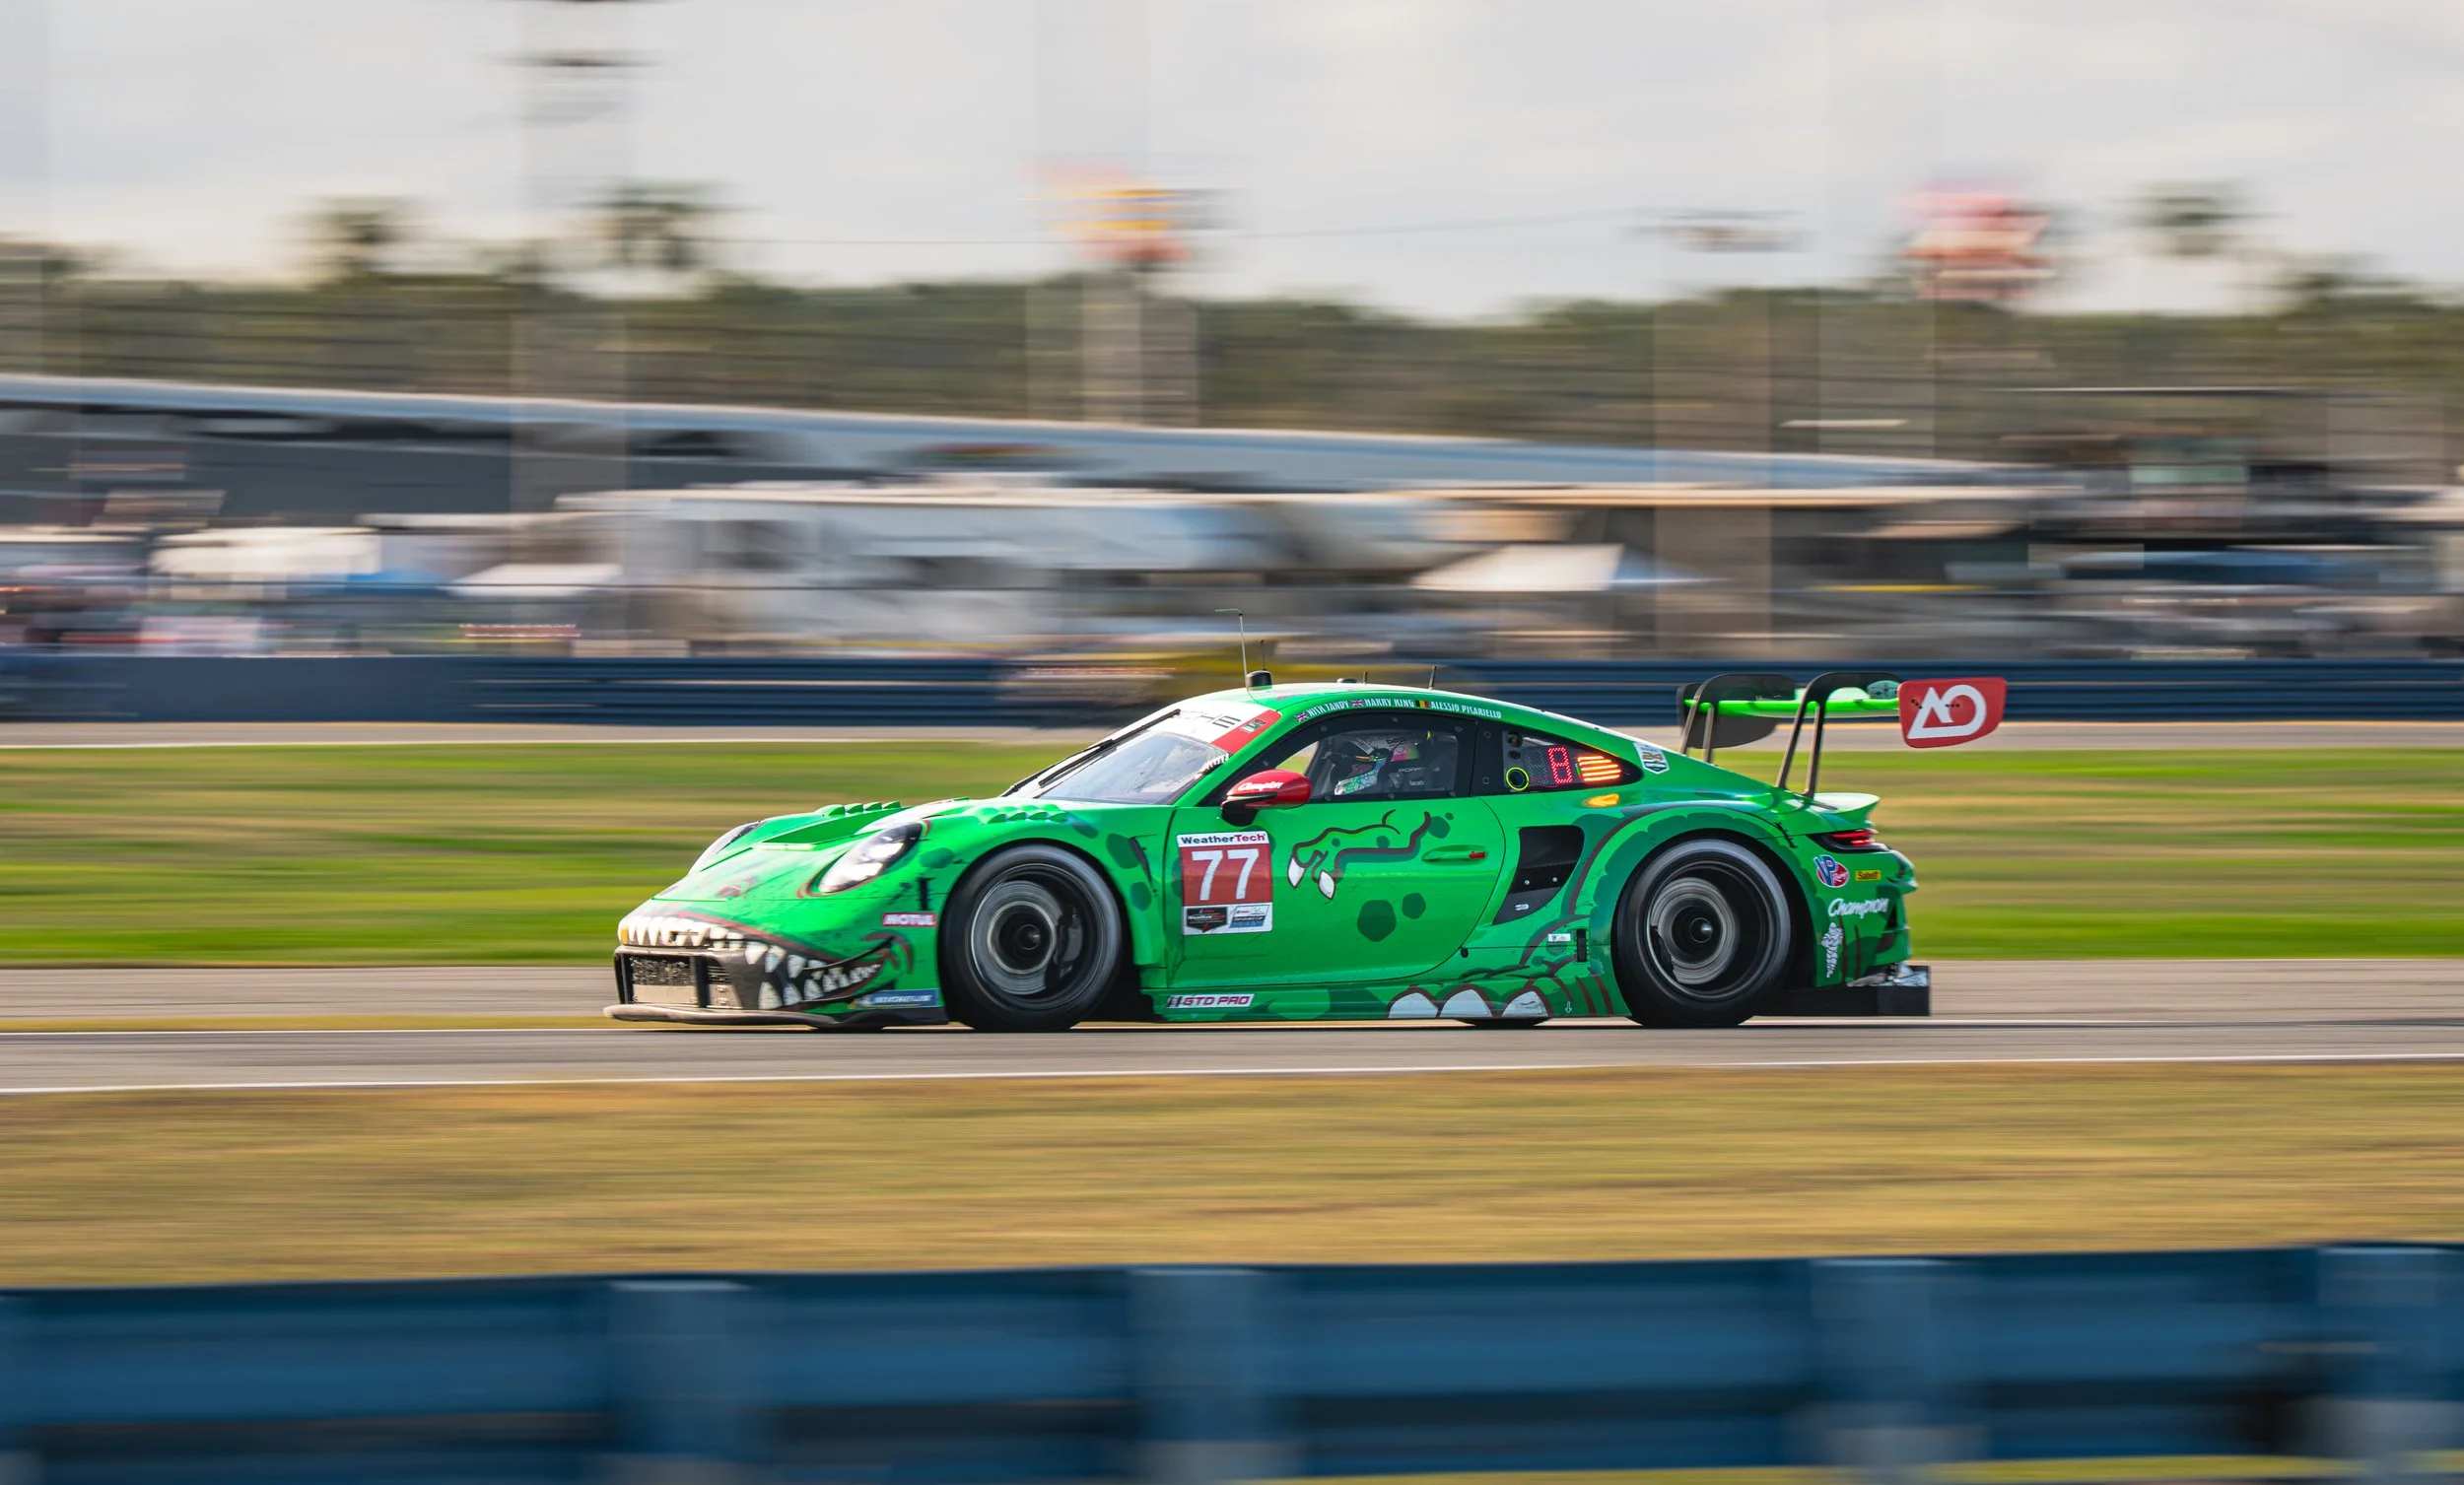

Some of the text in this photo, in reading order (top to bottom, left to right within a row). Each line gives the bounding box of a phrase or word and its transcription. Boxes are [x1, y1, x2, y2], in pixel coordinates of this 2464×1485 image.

[1327, 701, 1349, 711] TANDY
[1364, 698, 1415, 708] HARRY KING
[1431, 701, 1460, 712] ALESSIO
[1181, 833, 1266, 844] WeatherTech
[1192, 848, 1260, 901] 77
[1814, 854, 1838, 886] VP
[1827, 898, 1889, 919] Champion
[1182, 996, 1215, 1006] GTD
[1217, 995, 1251, 1005] PRO
